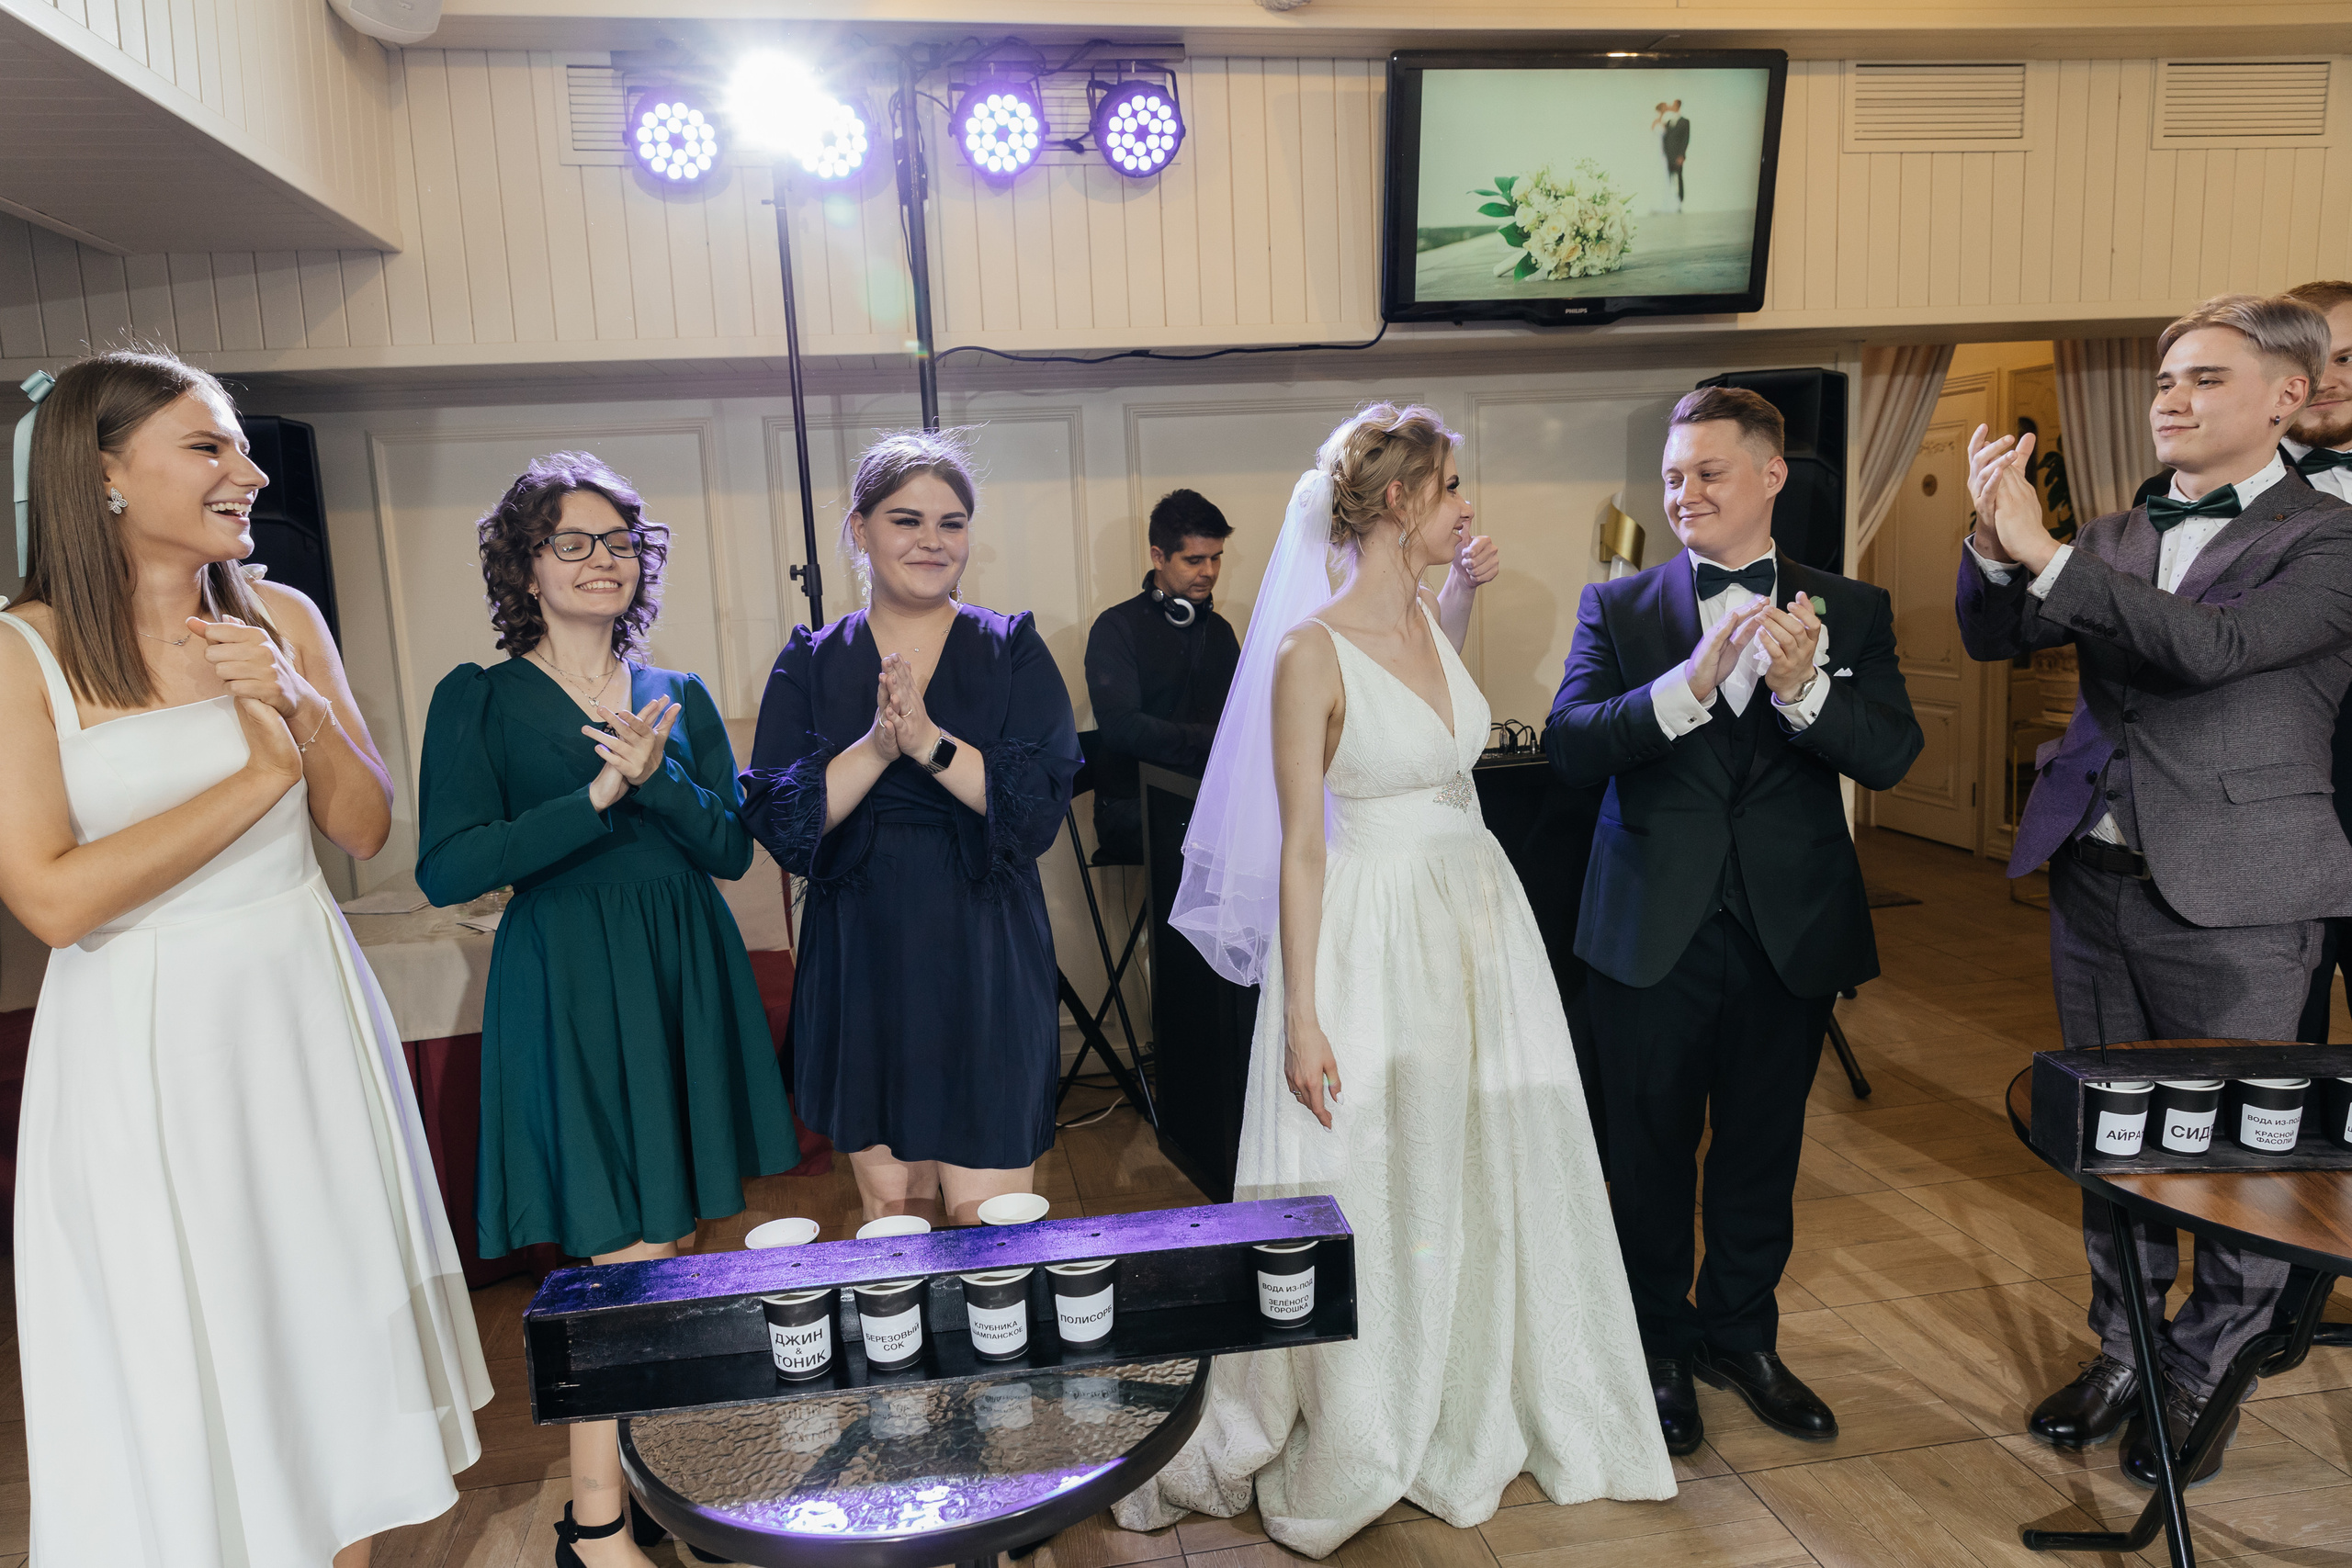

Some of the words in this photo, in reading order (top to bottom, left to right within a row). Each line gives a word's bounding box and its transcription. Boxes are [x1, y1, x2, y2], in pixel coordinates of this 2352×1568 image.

[2247, 1114, 2273, 1125] ВОДА
[2255, 1129, 2295, 1139] КРАСНОЙ
[1261, 1282, 1284, 1292] ВОДА
[1285, 1278, 1313, 1292] ИЗ-ПОД
[1268, 1294, 1309, 1306] ЗЕЛЁНОГО
[1060, 1303, 1113, 1325] ПОЛИСОРБ
[1270, 1303, 1308, 1313] ГОРОШКА
[974, 1320, 1018, 1331] КЛУБНИКА
[775, 1328, 823, 1347] ДЖИН
[865, 1322, 920, 1343] БЕРЕЗОВЫЙ
[972, 1326, 1023, 1340] ШАМПАНСКОЕ
[883, 1341, 905, 1351] СОК
[775, 1349, 826, 1368] ТОНИК
